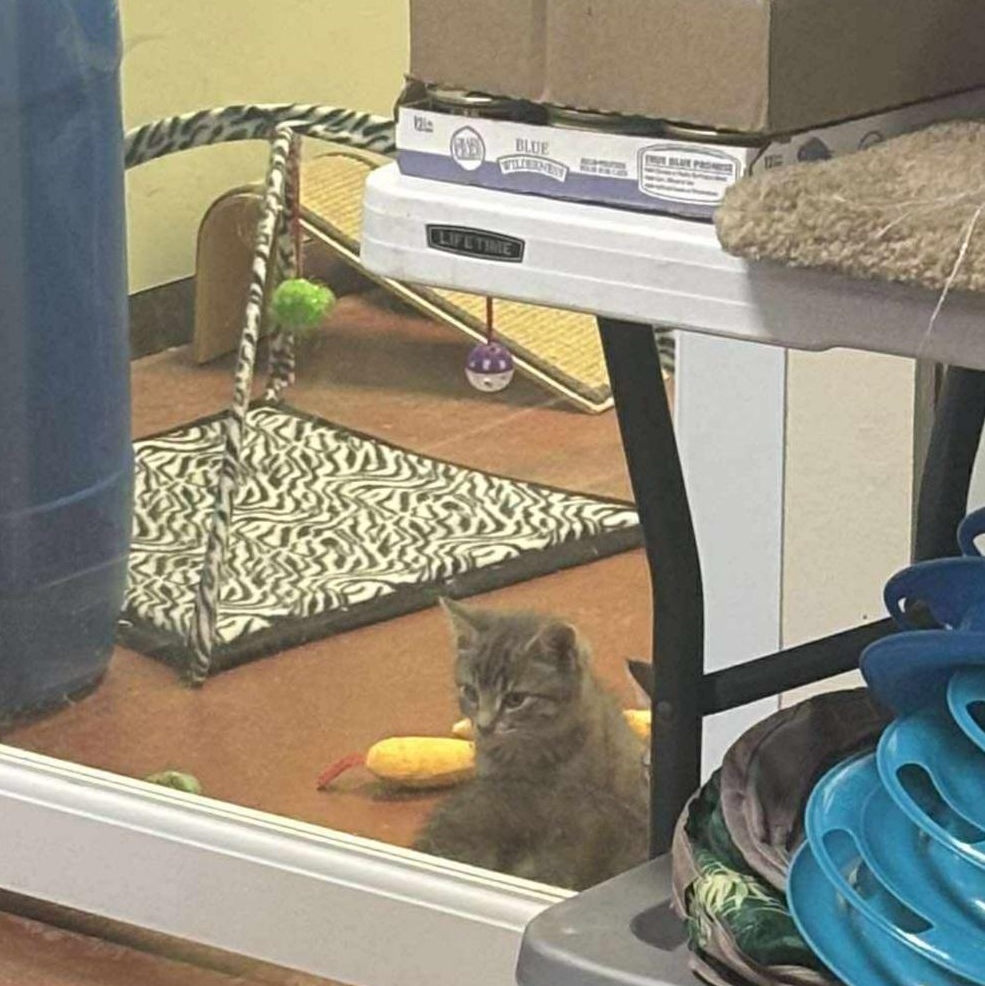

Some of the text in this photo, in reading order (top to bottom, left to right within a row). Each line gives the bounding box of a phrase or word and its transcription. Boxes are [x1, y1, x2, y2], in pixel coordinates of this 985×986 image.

[515, 138, 550, 155] BLUE
[501, 159, 566, 178] WILDERNESS
[439, 229, 513, 256] LIFETIME
